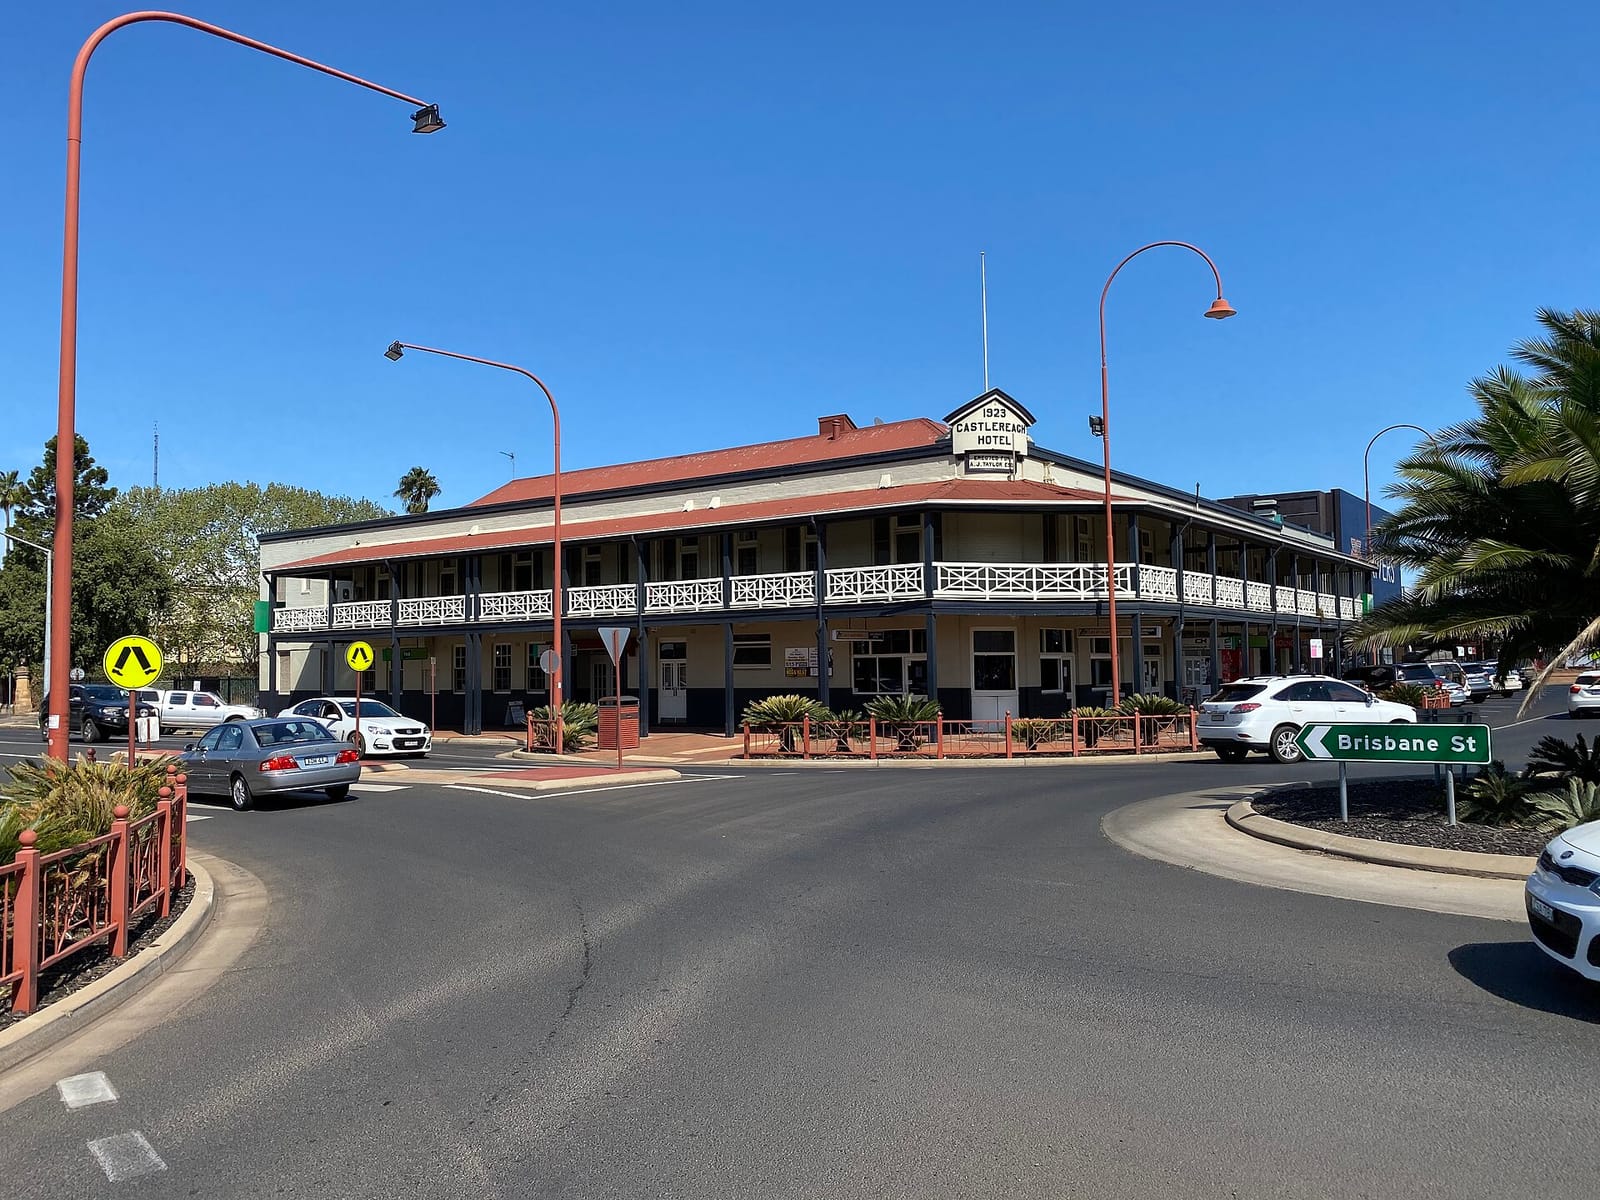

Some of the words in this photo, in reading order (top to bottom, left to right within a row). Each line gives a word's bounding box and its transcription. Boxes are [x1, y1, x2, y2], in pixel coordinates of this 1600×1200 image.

[983, 408, 1006, 418] 1923
[956, 422, 1026, 434] CASTLEREAGH
[977, 435, 1011, 445] HOTEL
[1338, 734, 1439, 752] Brisbane
[1451, 734, 1477, 753] St
